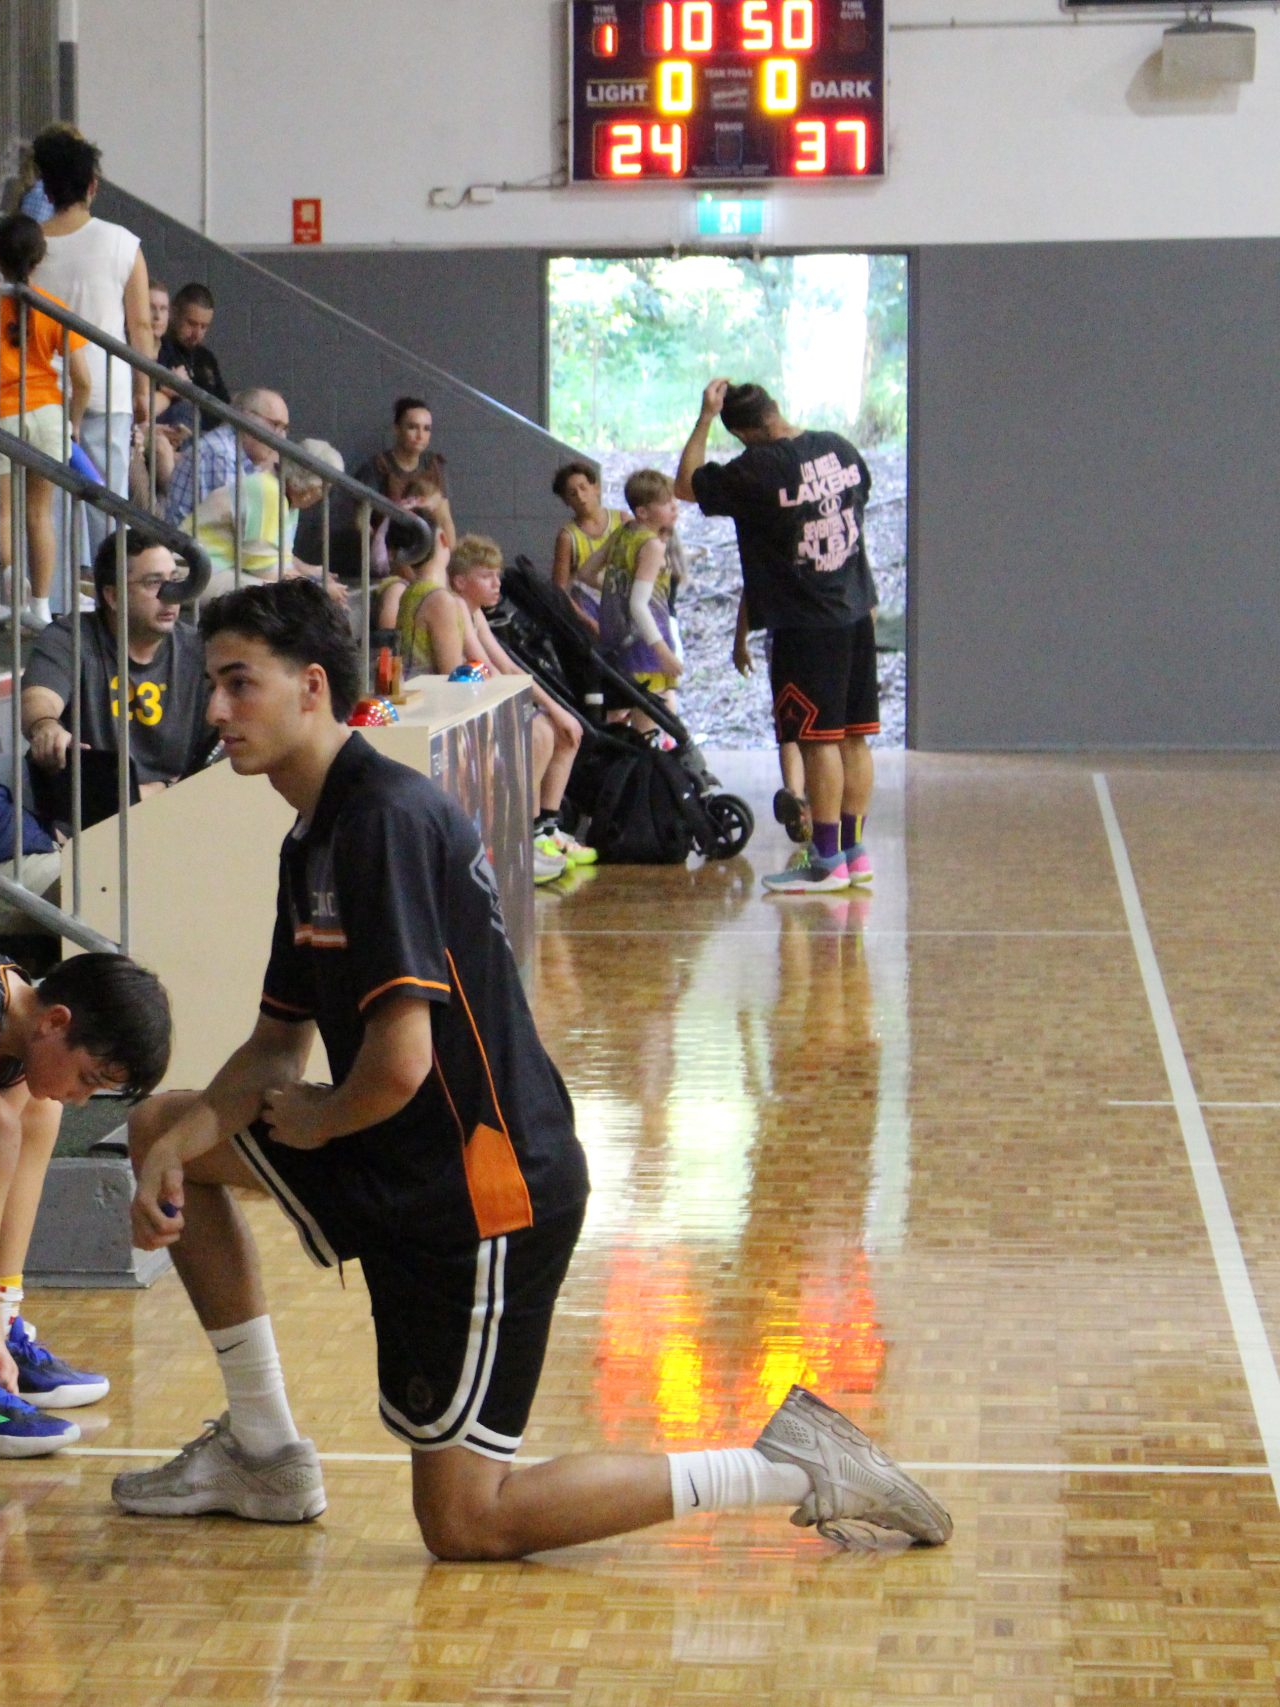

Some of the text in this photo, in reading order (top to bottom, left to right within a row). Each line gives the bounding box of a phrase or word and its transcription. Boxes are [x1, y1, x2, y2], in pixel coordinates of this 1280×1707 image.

[605, 25, 613, 53] 1
[586, 84, 648, 102] LIGHT
[661, 61, 694, 113] 0
[763, 59, 798, 111] 0
[810, 80, 872, 98] DARK
[611, 124, 682, 175] 24
[795, 121, 866, 172] 37
[779, 464, 861, 507] LAKERS
